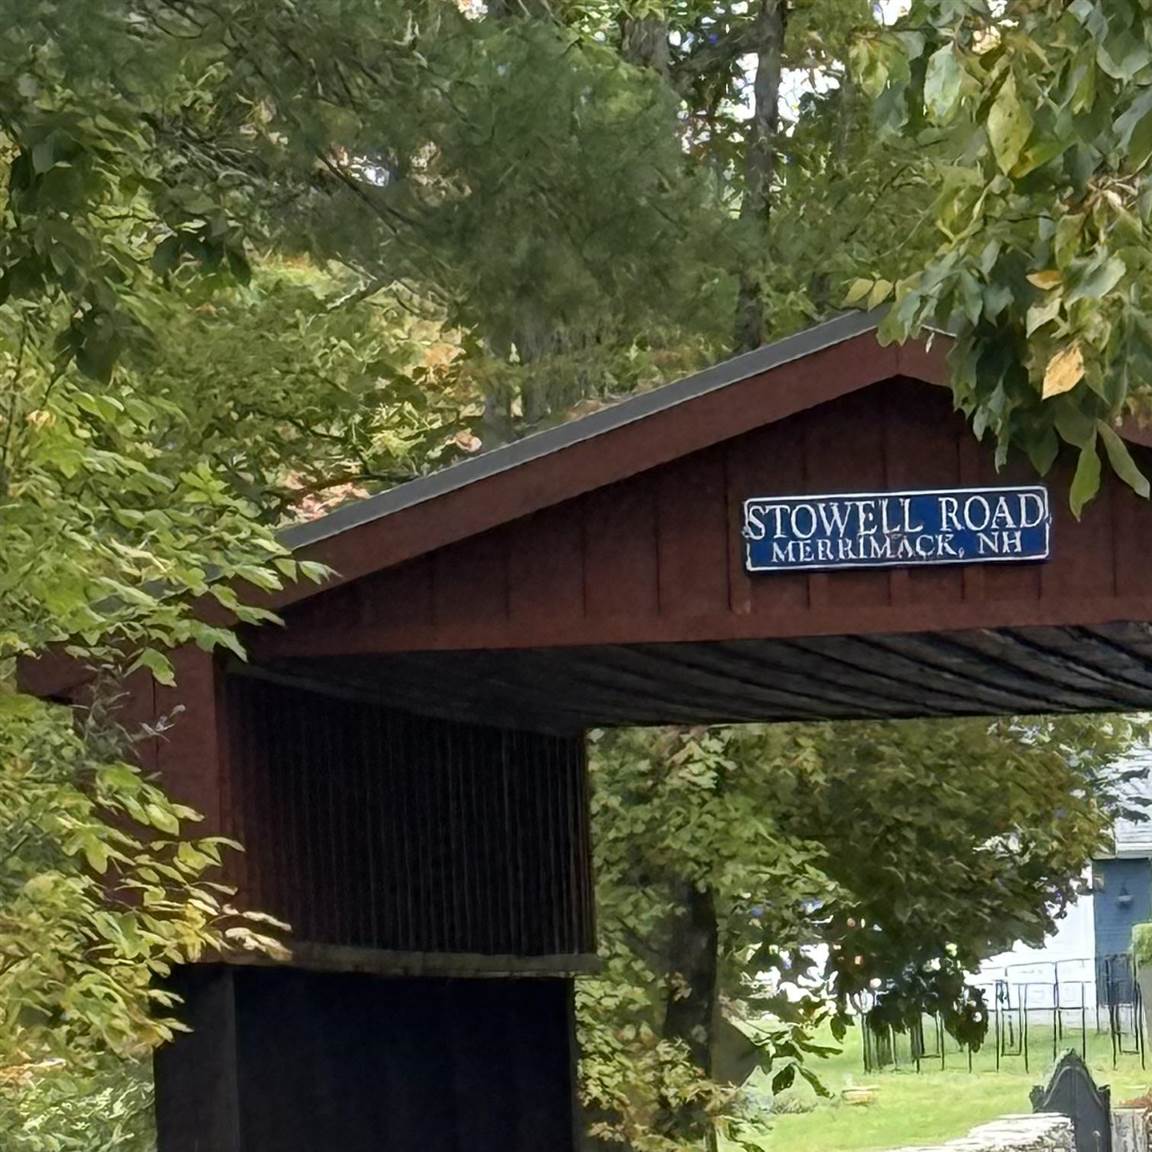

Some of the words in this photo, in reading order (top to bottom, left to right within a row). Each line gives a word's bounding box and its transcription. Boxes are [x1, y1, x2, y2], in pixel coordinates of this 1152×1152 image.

[747, 497, 923, 540] STOWELL
[938, 492, 1047, 532] ROAD
[977, 530, 1022, 555] NH
